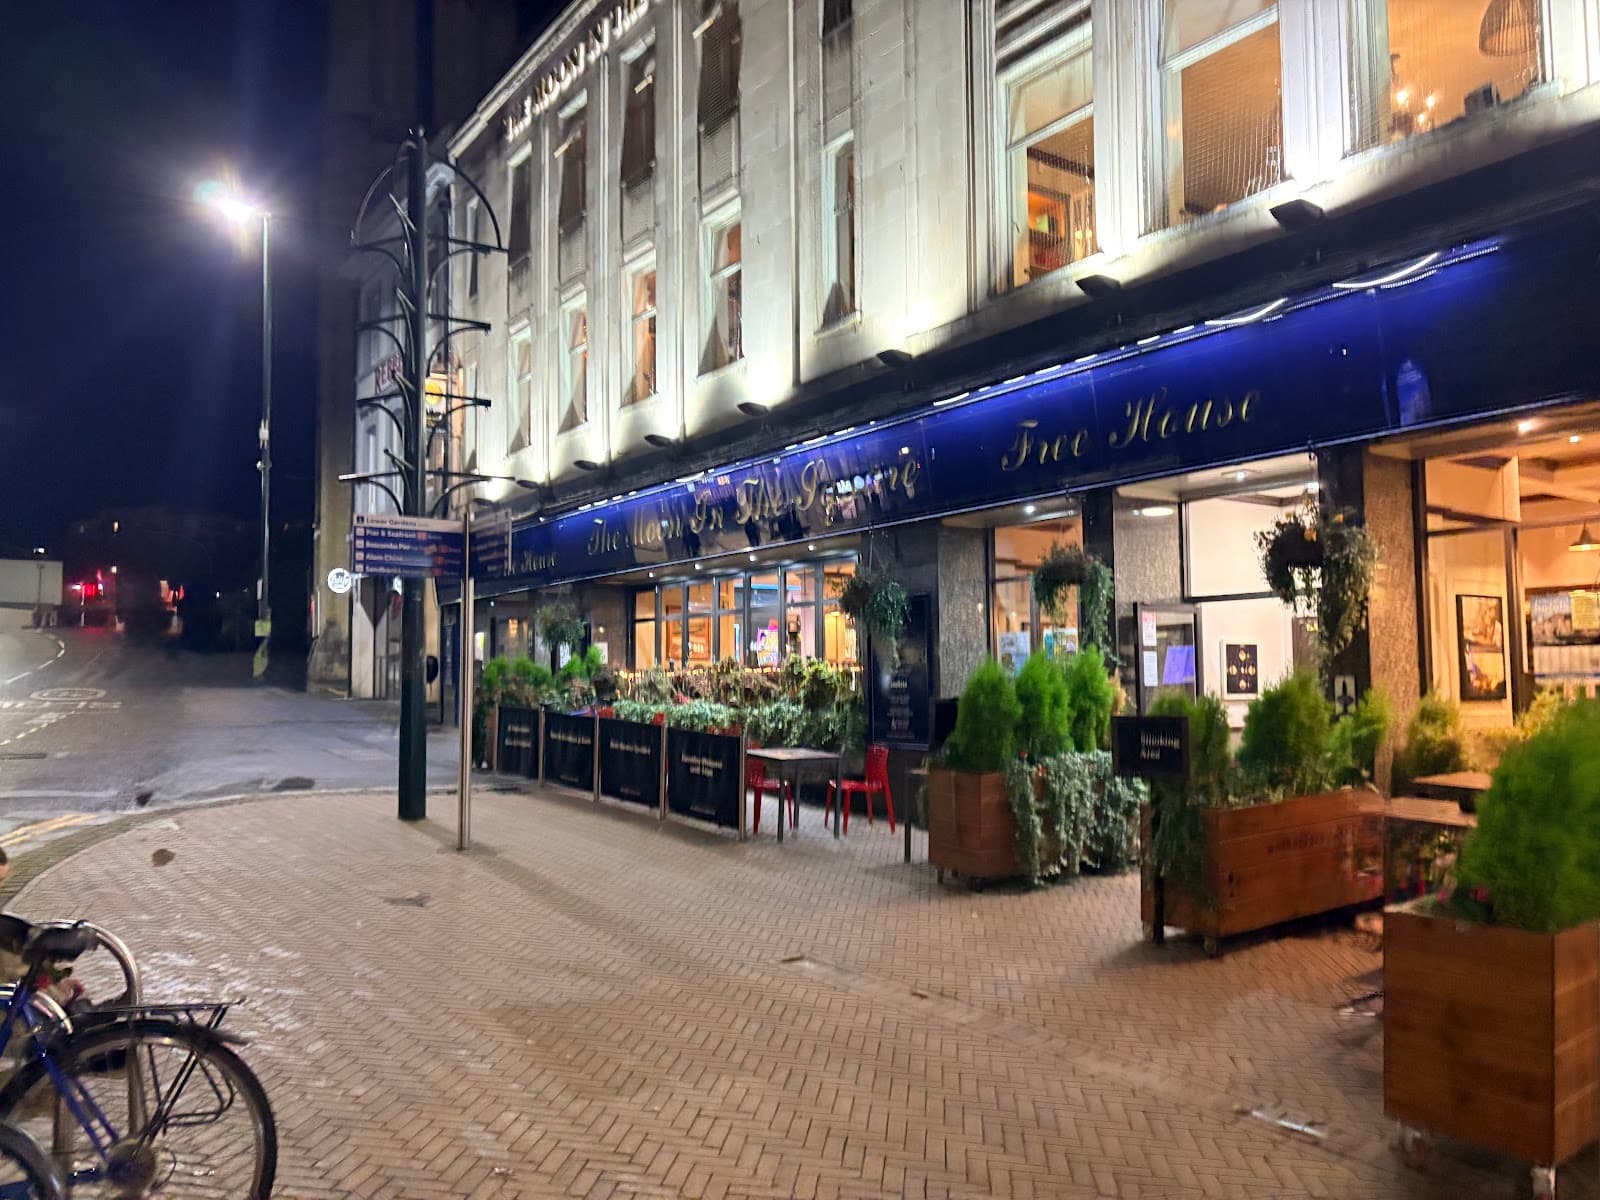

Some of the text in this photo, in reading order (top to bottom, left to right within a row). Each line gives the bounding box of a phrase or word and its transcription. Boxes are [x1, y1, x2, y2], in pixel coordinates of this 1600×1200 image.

[1001, 386, 1260, 471] Free House
[366, 516, 388, 525] Lower
[389, 517, 417, 527] Gardens
[588, 517, 620, 555] The
[690, 488, 724, 534] In
